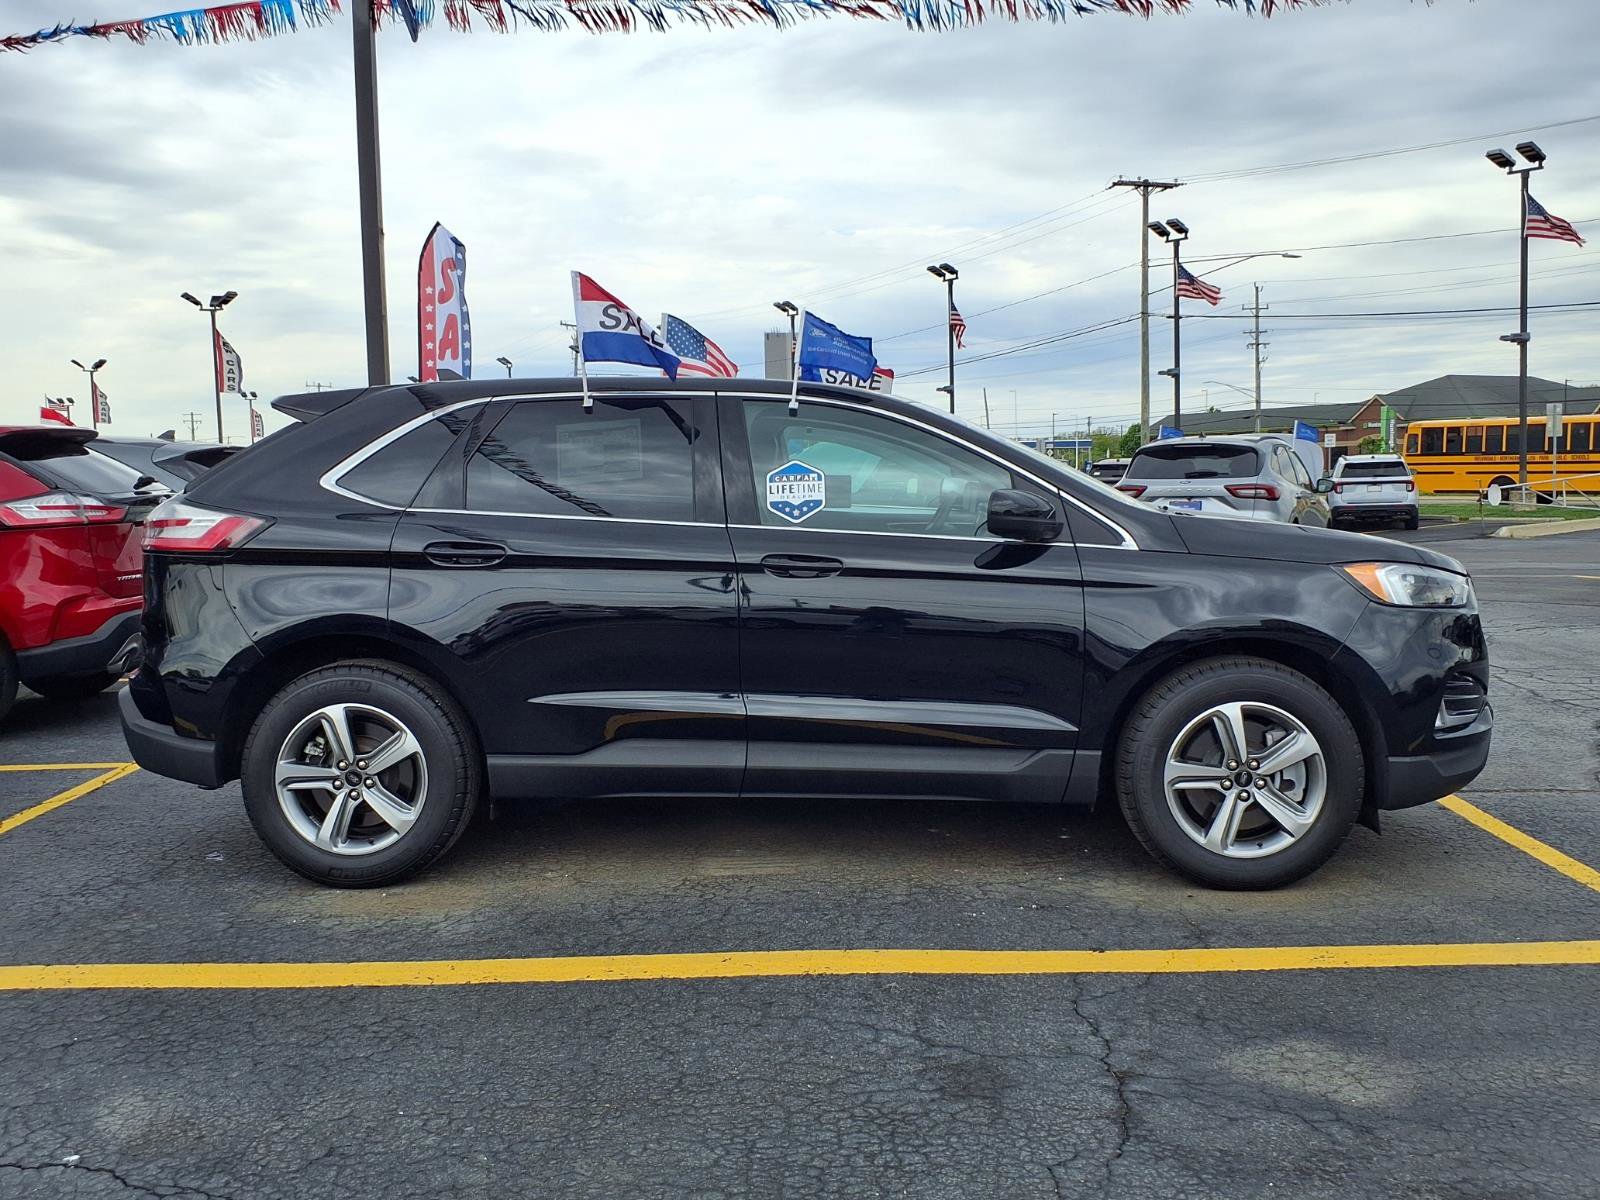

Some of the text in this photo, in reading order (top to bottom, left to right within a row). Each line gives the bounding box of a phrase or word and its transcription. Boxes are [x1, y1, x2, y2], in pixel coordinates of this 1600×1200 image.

[226, 360, 236, 391] CARS
[825, 369, 882, 391] SALE
[769, 484, 823, 494] LIFETIME
